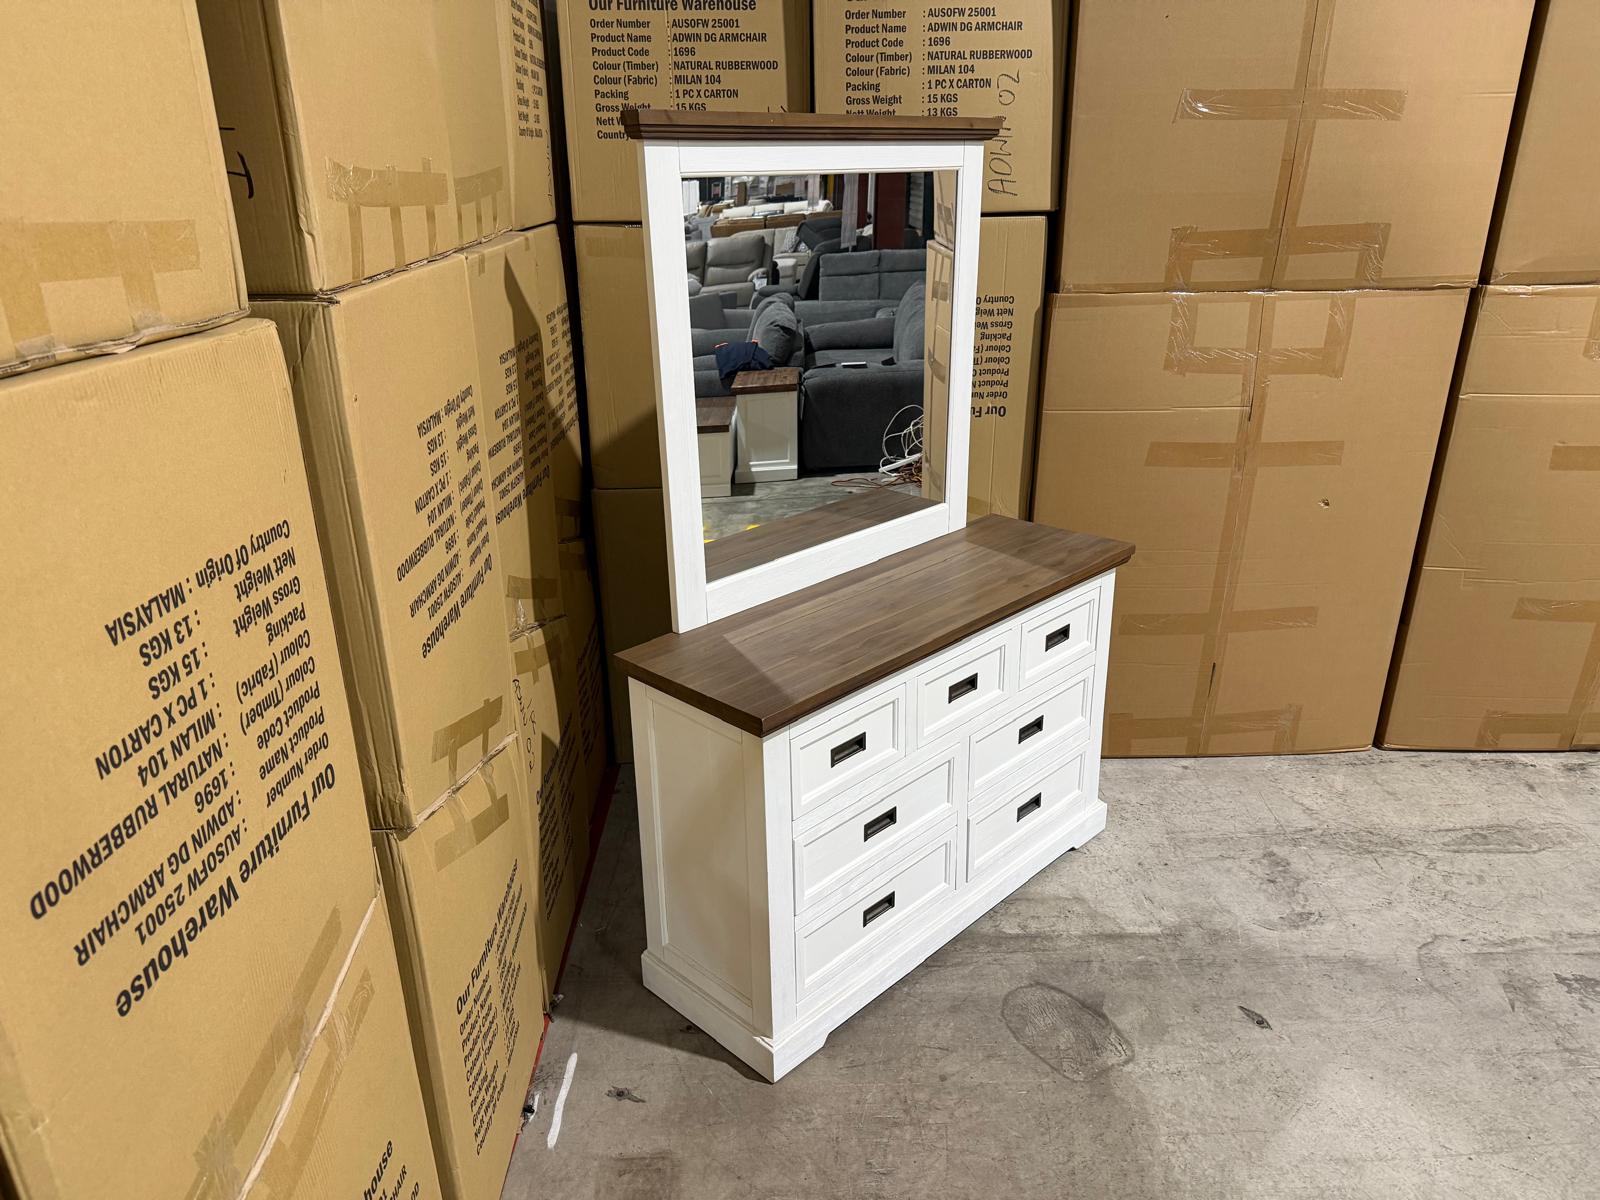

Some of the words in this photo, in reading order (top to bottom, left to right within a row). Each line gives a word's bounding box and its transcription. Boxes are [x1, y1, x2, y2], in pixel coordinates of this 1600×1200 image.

[588, 0, 612, 11] Our
[617, 0, 678, 11] Furniture
[683, 0, 756, 11] Warehouse
[845, 10, 870, 19] Order
[872, 9, 906, 19] Number
[927, 8, 966, 17] AUSOFW
[968, 7, 996, 17] 25001
[590, 18, 614, 28] Order
[616, 18, 651, 28] Number
[671, 18, 710, 28] AUSOFW
[712, 18, 740, 28] 25001
[845, 24, 879, 34] Product
[882, 24, 906, 33] Name
[927, 22, 957, 32] ADWIN
[960, 22, 972, 31] DG
[974, 21, 1023, 31] ARMCHAIR
[591, 33, 625, 42] Product
[626, 33, 652, 42] Name
[672, 33, 702, 42] ADWIN
[704, 33, 717, 42] DG
[719, 33, 767, 42] ARMCHAIR
[592, 47, 626, 56] Product
[627, 47, 650, 56] Code
[674, 47, 696, 56] 1696
[845, 39, 879, 48] Product
[882, 38, 904, 47] Code
[928, 37, 951, 46] 1696
[592, 61, 621, 70] Colour
[623, 61, 658, 72] (Timber)
[673, 61, 713, 70] NATURAL
[716, 60, 778, 70] RUBBERWOOD
[845, 53, 874, 62] Colour
[876, 52, 912, 64] (Timber)
[927, 50, 968, 60] NATURAL
[970, 50, 1033, 60] RUBBERWOOD
[845, 67, 874, 76] Colour
[876, 66, 910, 78] (Fabric)
[927, 65, 955, 75] MILAN
[958, 64, 975, 74] 104
[593, 75, 622, 85] Colour
[623, 75, 658, 87] (Fabric)
[674, 75, 702, 85] MILAN
[705, 75, 721, 85] 104
[594, 89, 629, 100] Packing
[675, 89, 680, 98] 1
[682, 89, 694, 98] PC
[696, 89, 702, 98] X
[704, 89, 738, 98] CARTON
[846, 81, 880, 92] Packing
[928, 80, 932, 89] 1
[935, 79, 946, 89] PC
[948, 79, 955, 89] X
[956, 78, 992, 88] CARTON
[595, 103, 620, 112] Gross
[676, 103, 687, 111] 15
[689, 103, 706, 111] KGS
[846, 96, 870, 105] Gross
[872, 95, 902, 106] Weight
[927, 94, 938, 103] 15
[940, 93, 958, 103] KGS
[927, 108, 938, 116] 13
[940, 107, 958, 116] KGS
[596, 117, 614, 126] Nett
[983, 295, 1014, 304] Country
[997, 308, 1014, 316] Nett
[980, 333, 1012, 341] Packing
[990, 320, 1013, 328] Gross
[985, 344, 1011, 352] Colour
[985, 356, 1010, 364] Colour
[978, 368, 1009, 376] Product
[978, 380, 1008, 388] Product
[417, 410, 441, 438] MALAYSIA
[985, 405, 1006, 417] Our
[427, 436, 437, 455] KGS
[438, 431, 443, 447] 13
[430, 458, 440, 476] KGS
[440, 452, 446, 468] 15
[435, 482, 439, 496] X
[439, 475, 446, 492] PC
[446, 472, 449, 486] 1
[415, 486, 435, 514] CARTON
[437, 493, 452, 516] MILAN
[428, 507, 437, 527] 104
[434, 512, 454, 542] NATURAL
[251, 520, 290, 555] Country
[446, 532, 456, 554] 1696
[196, 554, 234, 588] Origin
[236, 545, 248, 570] Of
[273, 547, 296, 576] Nett
[397, 533, 434, 581] RUBBERWOOD
[445, 551, 459, 578] ADWIN
[234, 563, 274, 602] Weight
[273, 576, 300, 605] Gross
[437, 569, 444, 586] DG
[444, 571, 461, 602] AUSOFW
[460, 566, 484, 608] Furniture
[410, 577, 436, 618] ARMCHAIR
[428, 593, 443, 620] 25001
[105, 582, 186, 646] MALAYSIA
[233, 596, 273, 637] Weight
[266, 602, 306, 646] Packing
[174, 615, 192, 644] 13
[422, 601, 460, 658] Warehouse
[140, 628, 172, 666] KGS
[280, 630, 310, 665] Colour
[182, 648, 200, 676] 15
[286, 656, 315, 692] Colour
[149, 662, 181, 699] KGS
[198, 679, 207, 700] 1
[236, 652, 278, 704] (Fabric)
[163, 702, 176, 728] X
[177, 687, 197, 716] PC
[240, 680, 283, 736] (Timber)
[283, 681, 320, 727] Product
[170, 709, 216, 761] MILAN
[257, 717, 283, 749] Code
[289, 706, 324, 753] Product
[96, 714, 162, 780] CARTON
[304, 732, 328, 765] Order
[138, 748, 168, 787] 104
[158, 739, 222, 806] NATURAL
[260, 743, 289, 780] Name
[195, 769, 228, 813] 1696
[267, 758, 304, 808] Number
[312, 764, 335, 802] Our
[191, 796, 234, 853] ADWIN
[239, 791, 310, 883] Furniture
[31, 794, 158, 919] RUBBERWOOD
[167, 841, 190, 874] DG
[188, 824, 240, 896] AUSOFW
[74, 863, 164, 966] ARMCHAIR
[135, 883, 185, 945] 25001
[116, 876, 239, 1016] Warehouse
